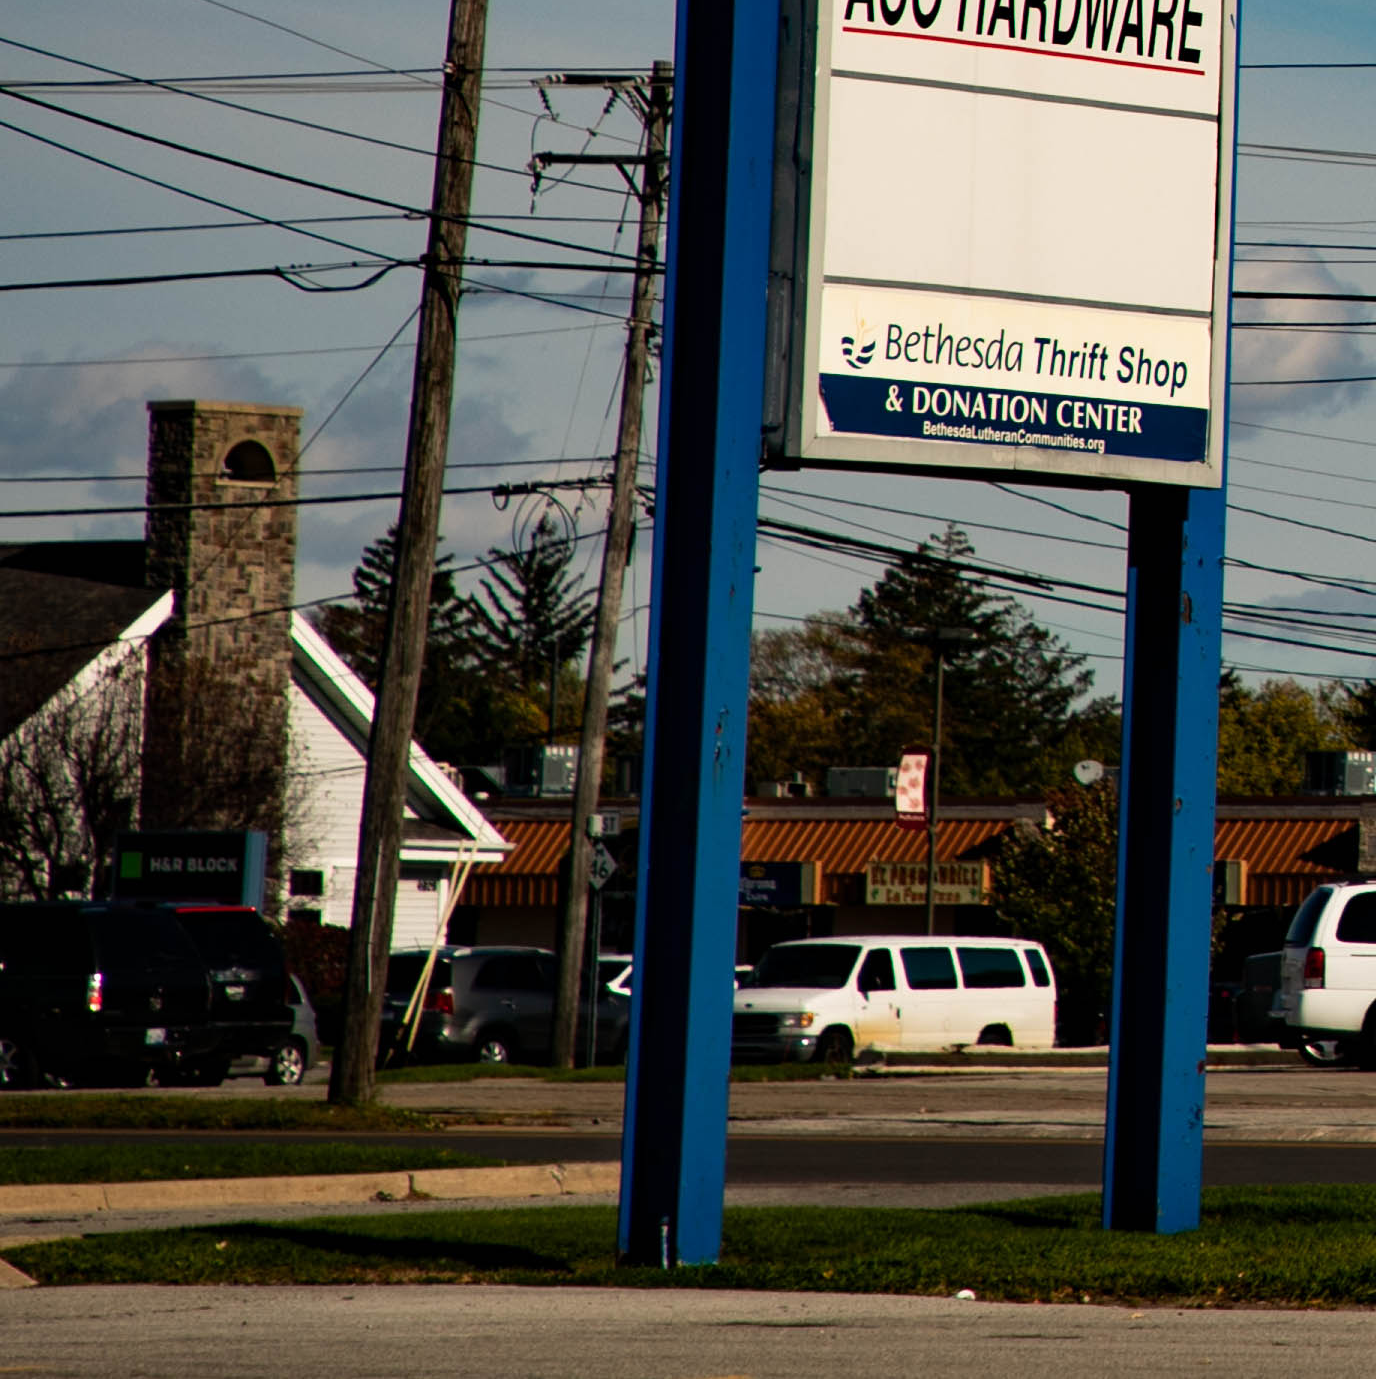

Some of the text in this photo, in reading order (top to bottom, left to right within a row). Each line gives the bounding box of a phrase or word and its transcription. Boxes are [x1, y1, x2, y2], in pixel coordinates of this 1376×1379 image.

[885, 323, 1188, 398] Bethesda Thrift Shop
[884, 385, 1143, 434] & DONATION CENTER
[923, 421, 1106, 454] BethesdaLutheranCommunities.org
[149, 855, 239, 873] H&R BLOCK
